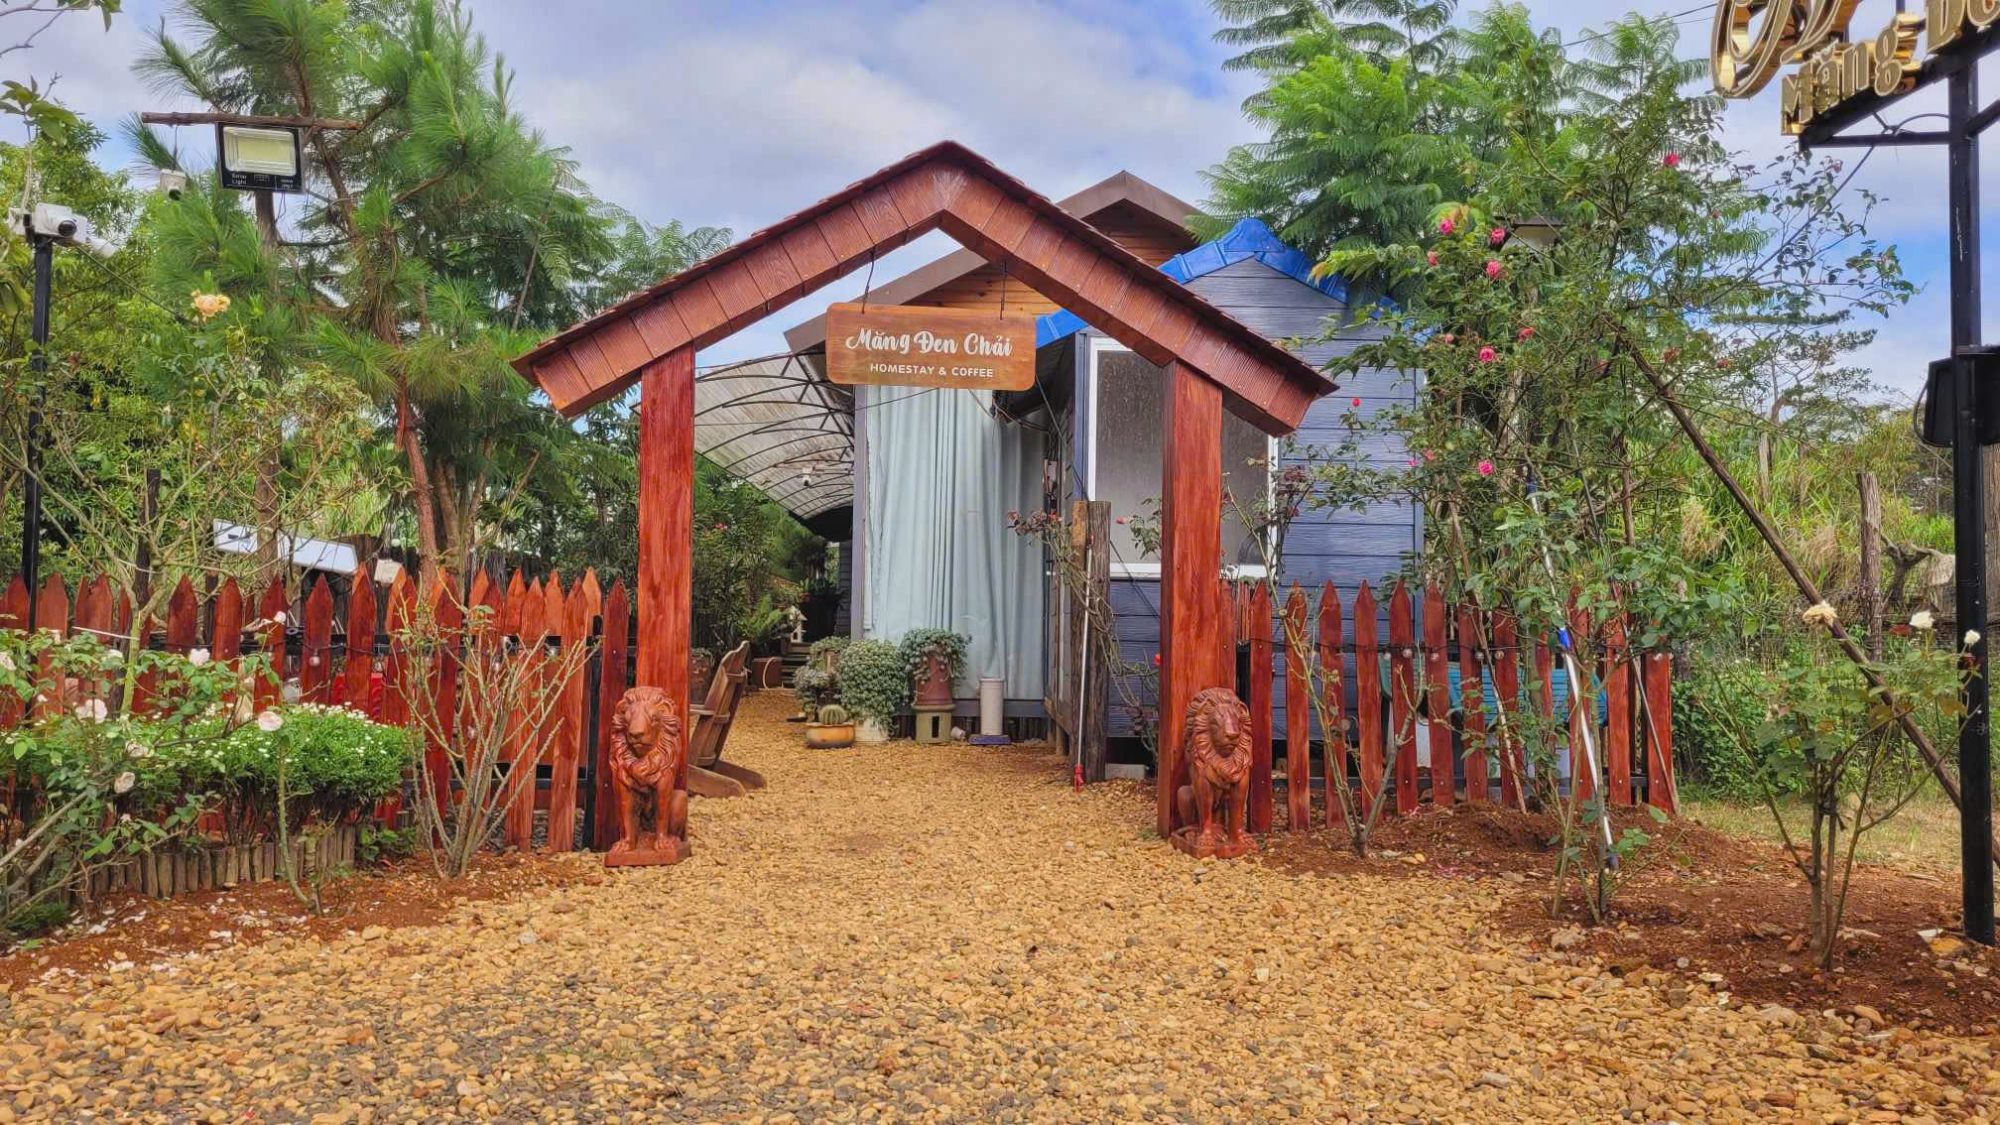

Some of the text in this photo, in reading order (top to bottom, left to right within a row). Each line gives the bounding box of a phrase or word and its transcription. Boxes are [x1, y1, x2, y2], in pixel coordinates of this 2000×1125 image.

[845, 328, 910, 355] Măng
[913, 331, 958, 354] Đen
[870, 363, 993, 378] HOMESTAY & COFFEE
